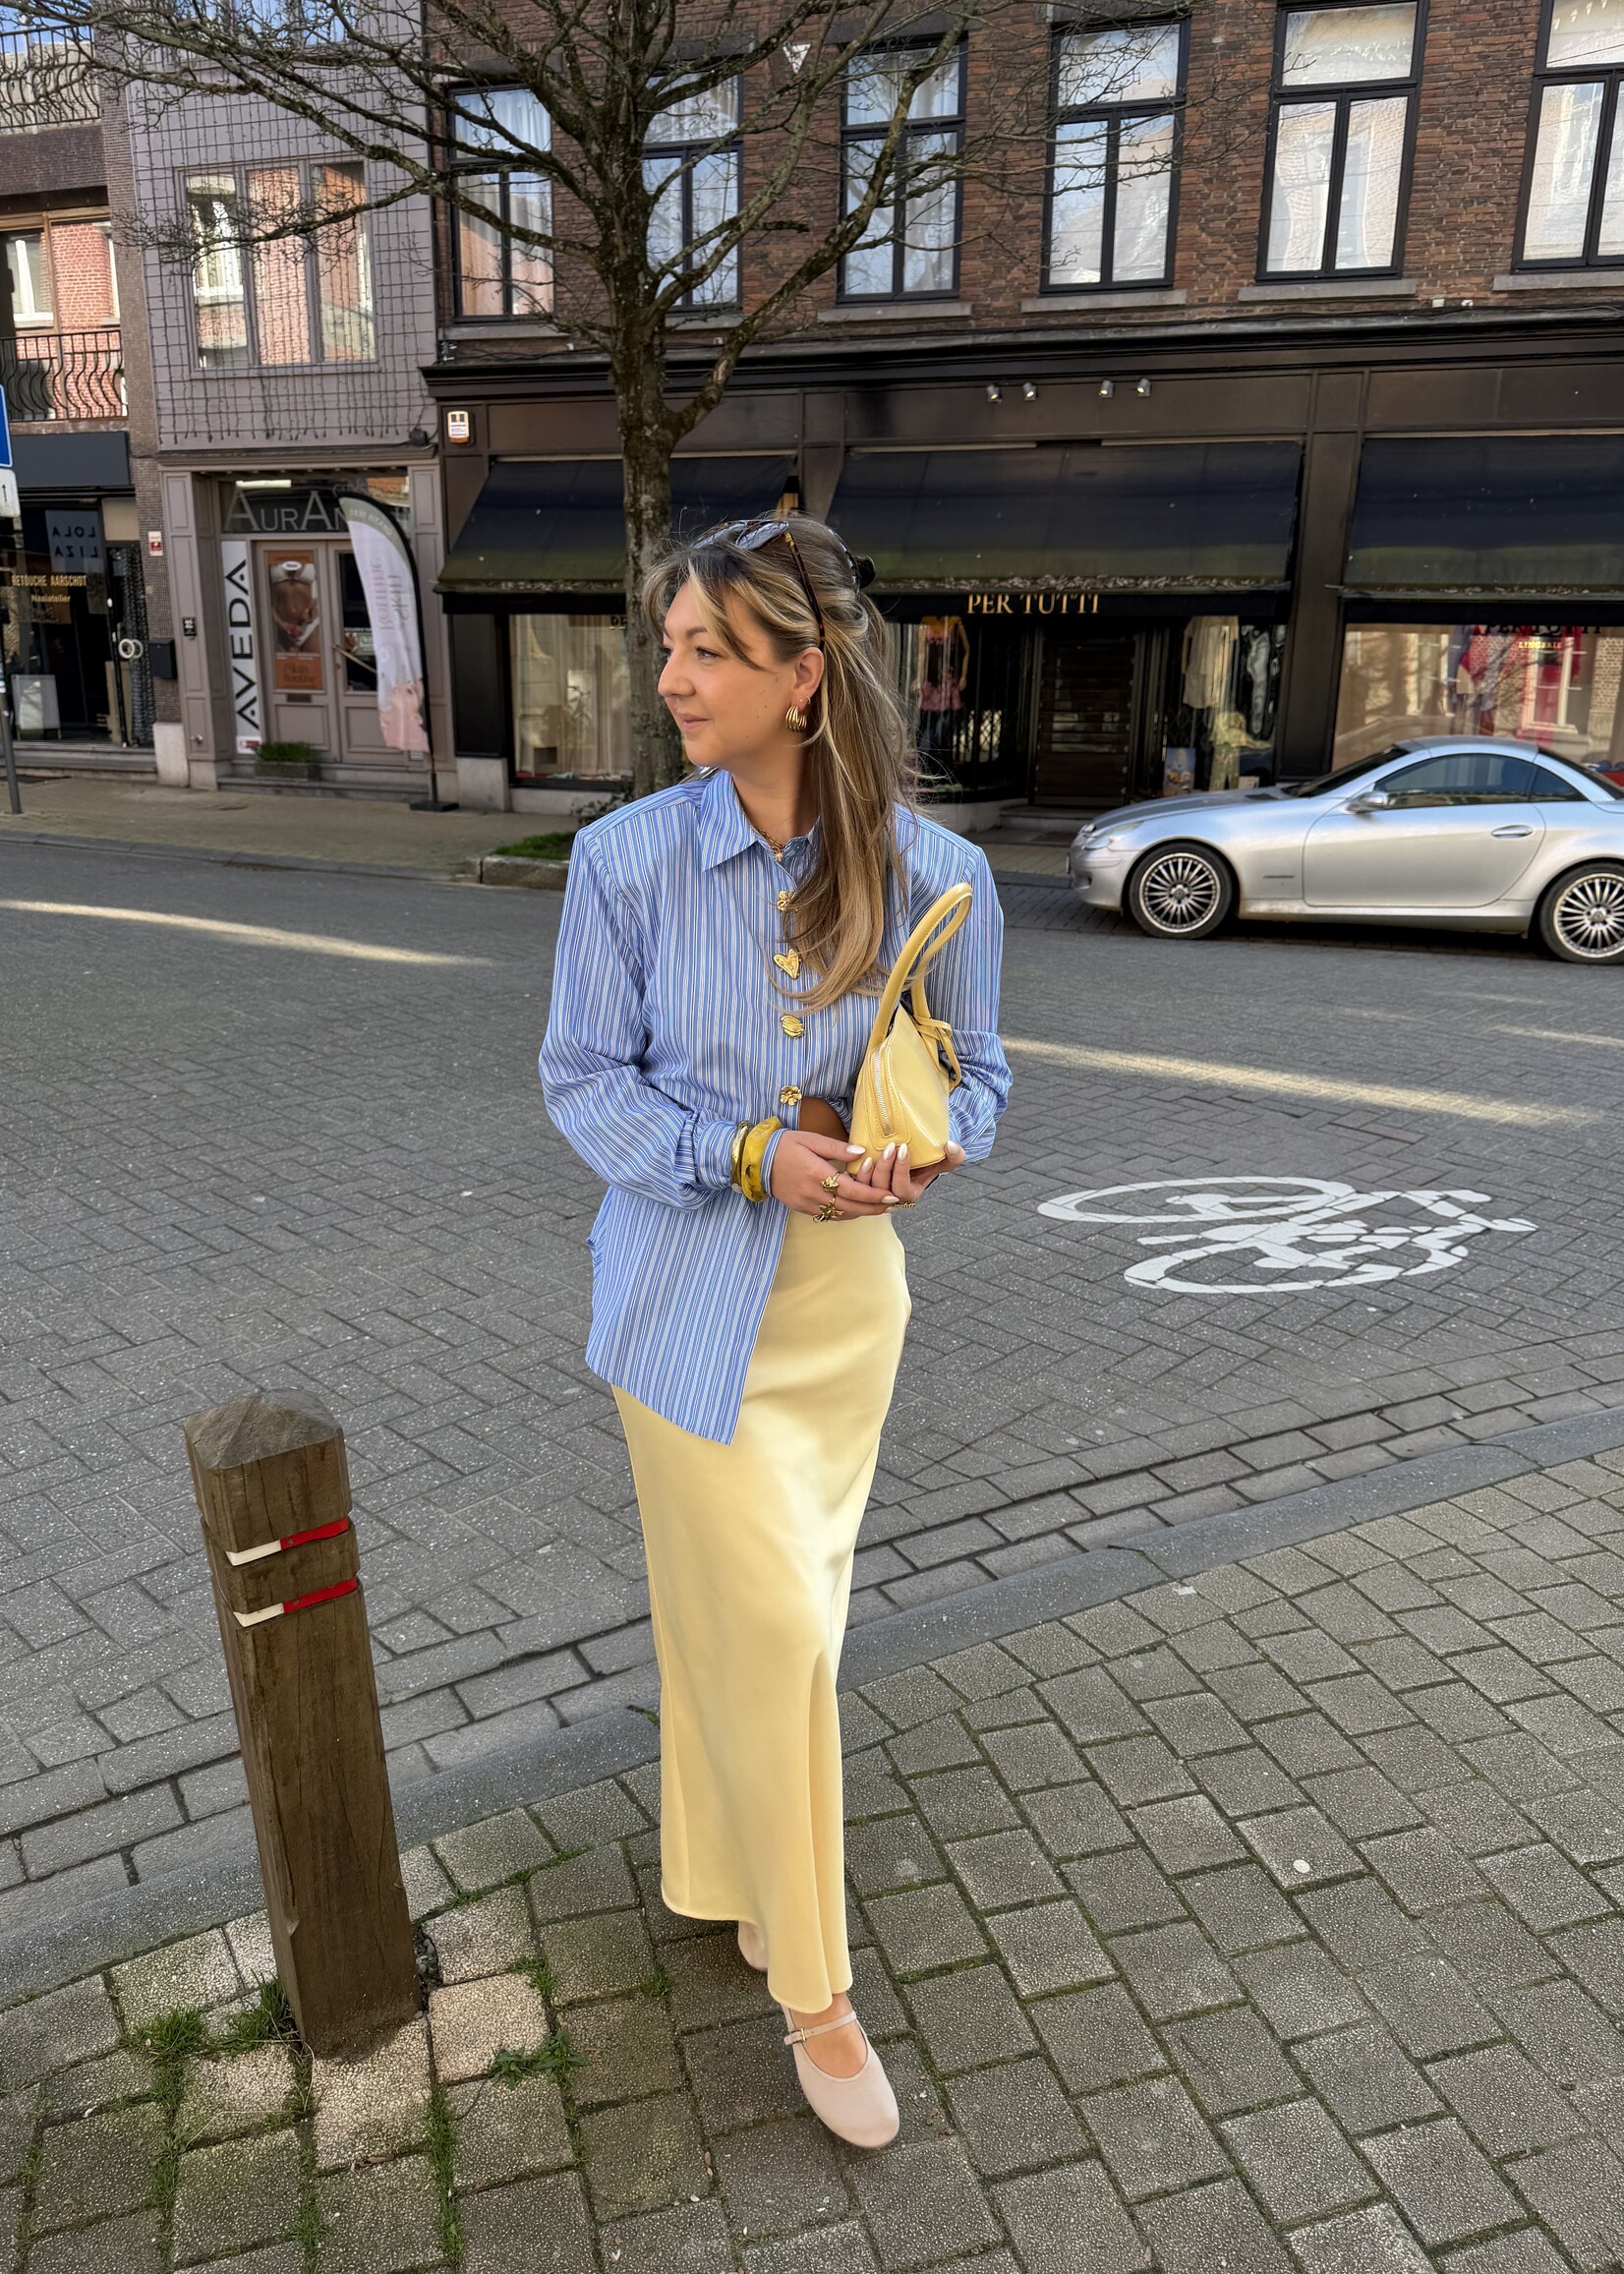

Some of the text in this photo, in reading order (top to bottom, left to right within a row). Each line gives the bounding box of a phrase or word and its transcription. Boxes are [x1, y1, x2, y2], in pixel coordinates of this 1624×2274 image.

[225, 558, 261, 730] AVEDA
[966, 593, 1099, 614] PER TUTTI
